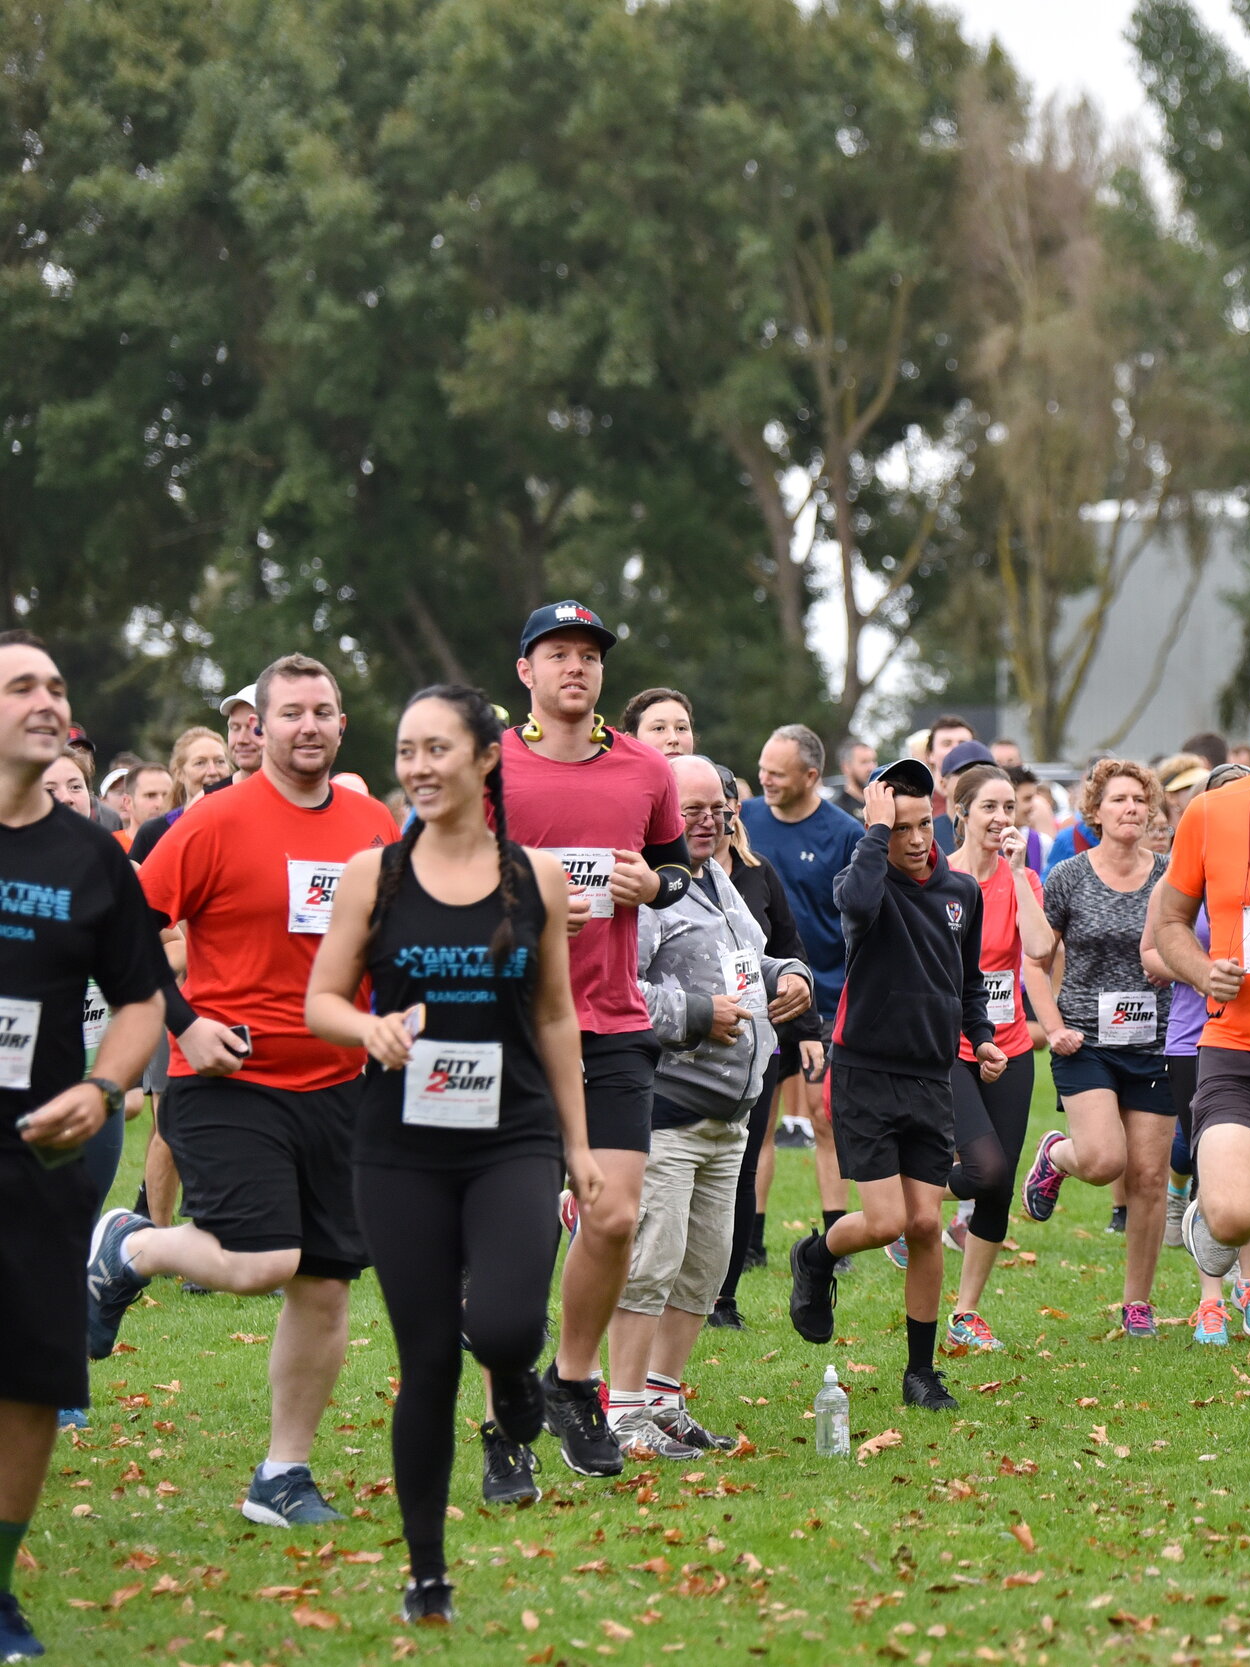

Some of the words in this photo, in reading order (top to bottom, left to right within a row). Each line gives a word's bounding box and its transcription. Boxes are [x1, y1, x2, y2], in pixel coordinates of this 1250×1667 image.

[425, 989, 498, 1003] RANGIORA
[1115, 1002, 1144, 1012] CITY
[433, 1059, 479, 1075] CITY
